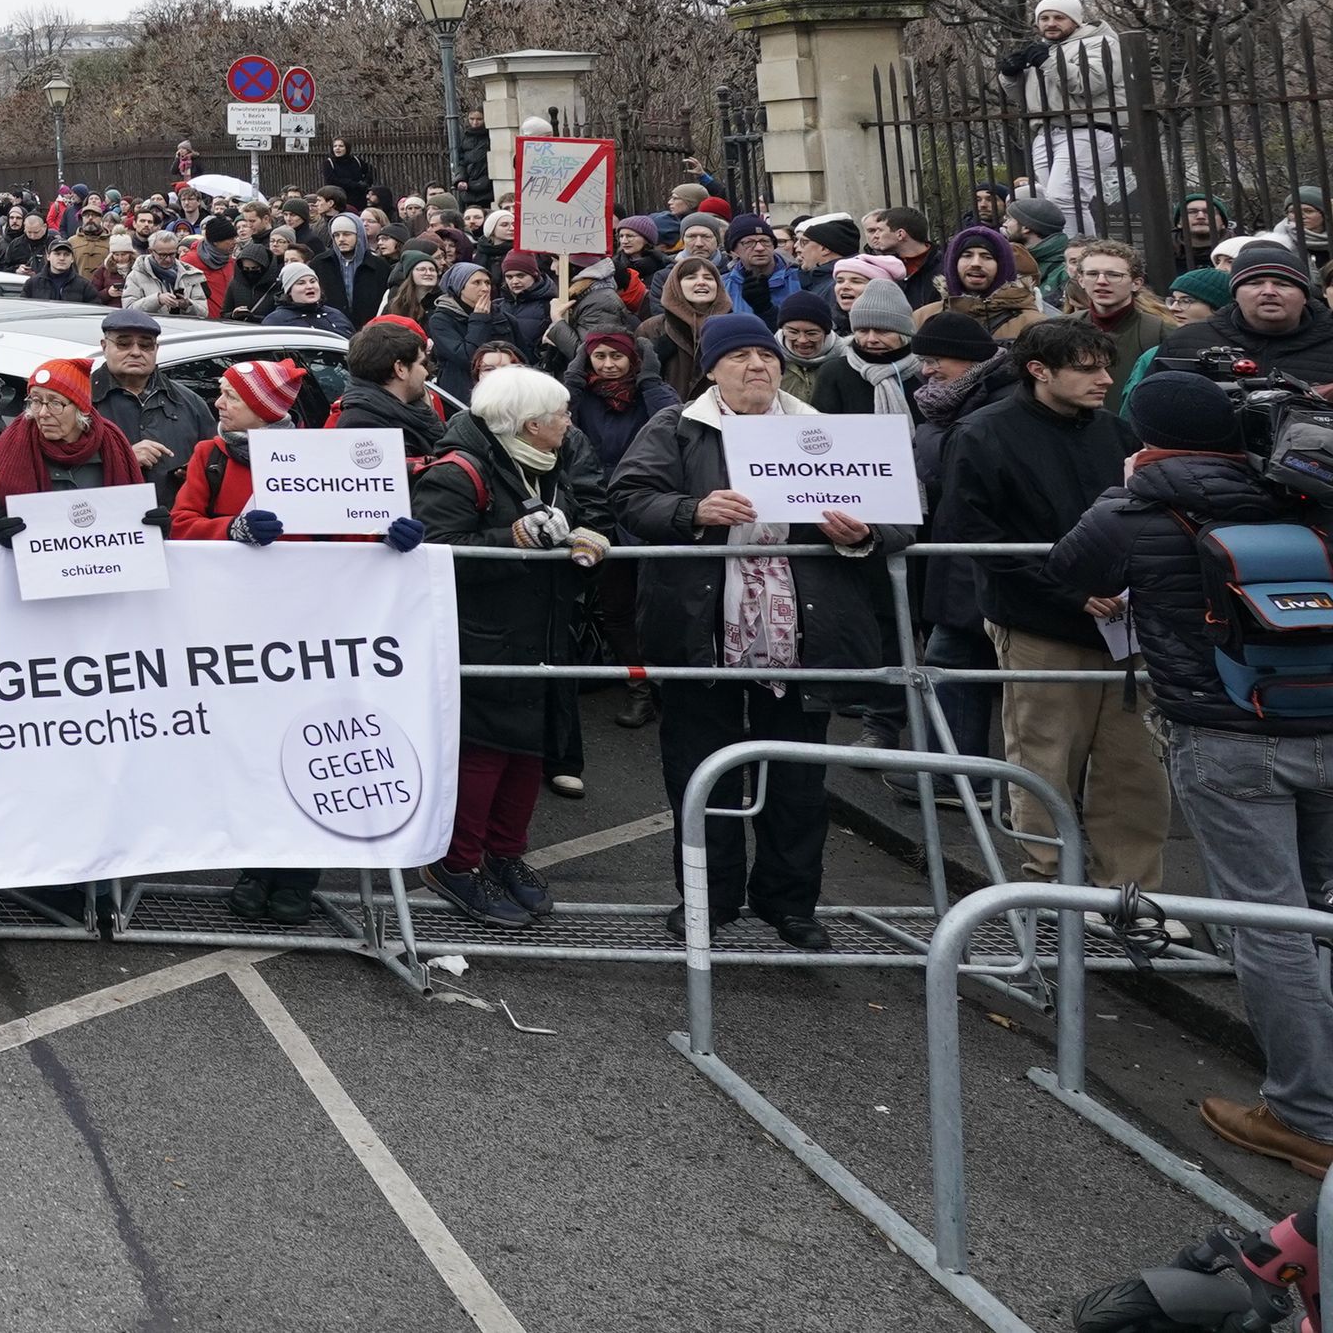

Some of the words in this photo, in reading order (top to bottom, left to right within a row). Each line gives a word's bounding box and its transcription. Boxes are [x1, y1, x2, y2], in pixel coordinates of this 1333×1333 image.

[355, 441, 374, 449] OMAS
[802, 435, 827, 444] GEGEN
[804, 442, 830, 451] RECHTS
[270, 451, 296, 462] Aus
[355, 448, 378, 457] GEGEN
[356, 456, 381, 465] RECHTS
[749, 463, 893, 477] DEMOKRATIE
[266, 477, 395, 492] GESCHICHTE
[787, 492, 861, 503] schützen
[72, 508, 92, 517] GEGEN
[346, 508, 390, 519] lernen
[30, 531, 145, 553] DEMOKRATIE
[61, 563, 121, 577] schützen
[186, 635, 404, 687] RECHTS
[302, 713, 381, 747] OMAS
[308, 747, 395, 781] GEGEN
[313, 779, 412, 816] RECHTS
